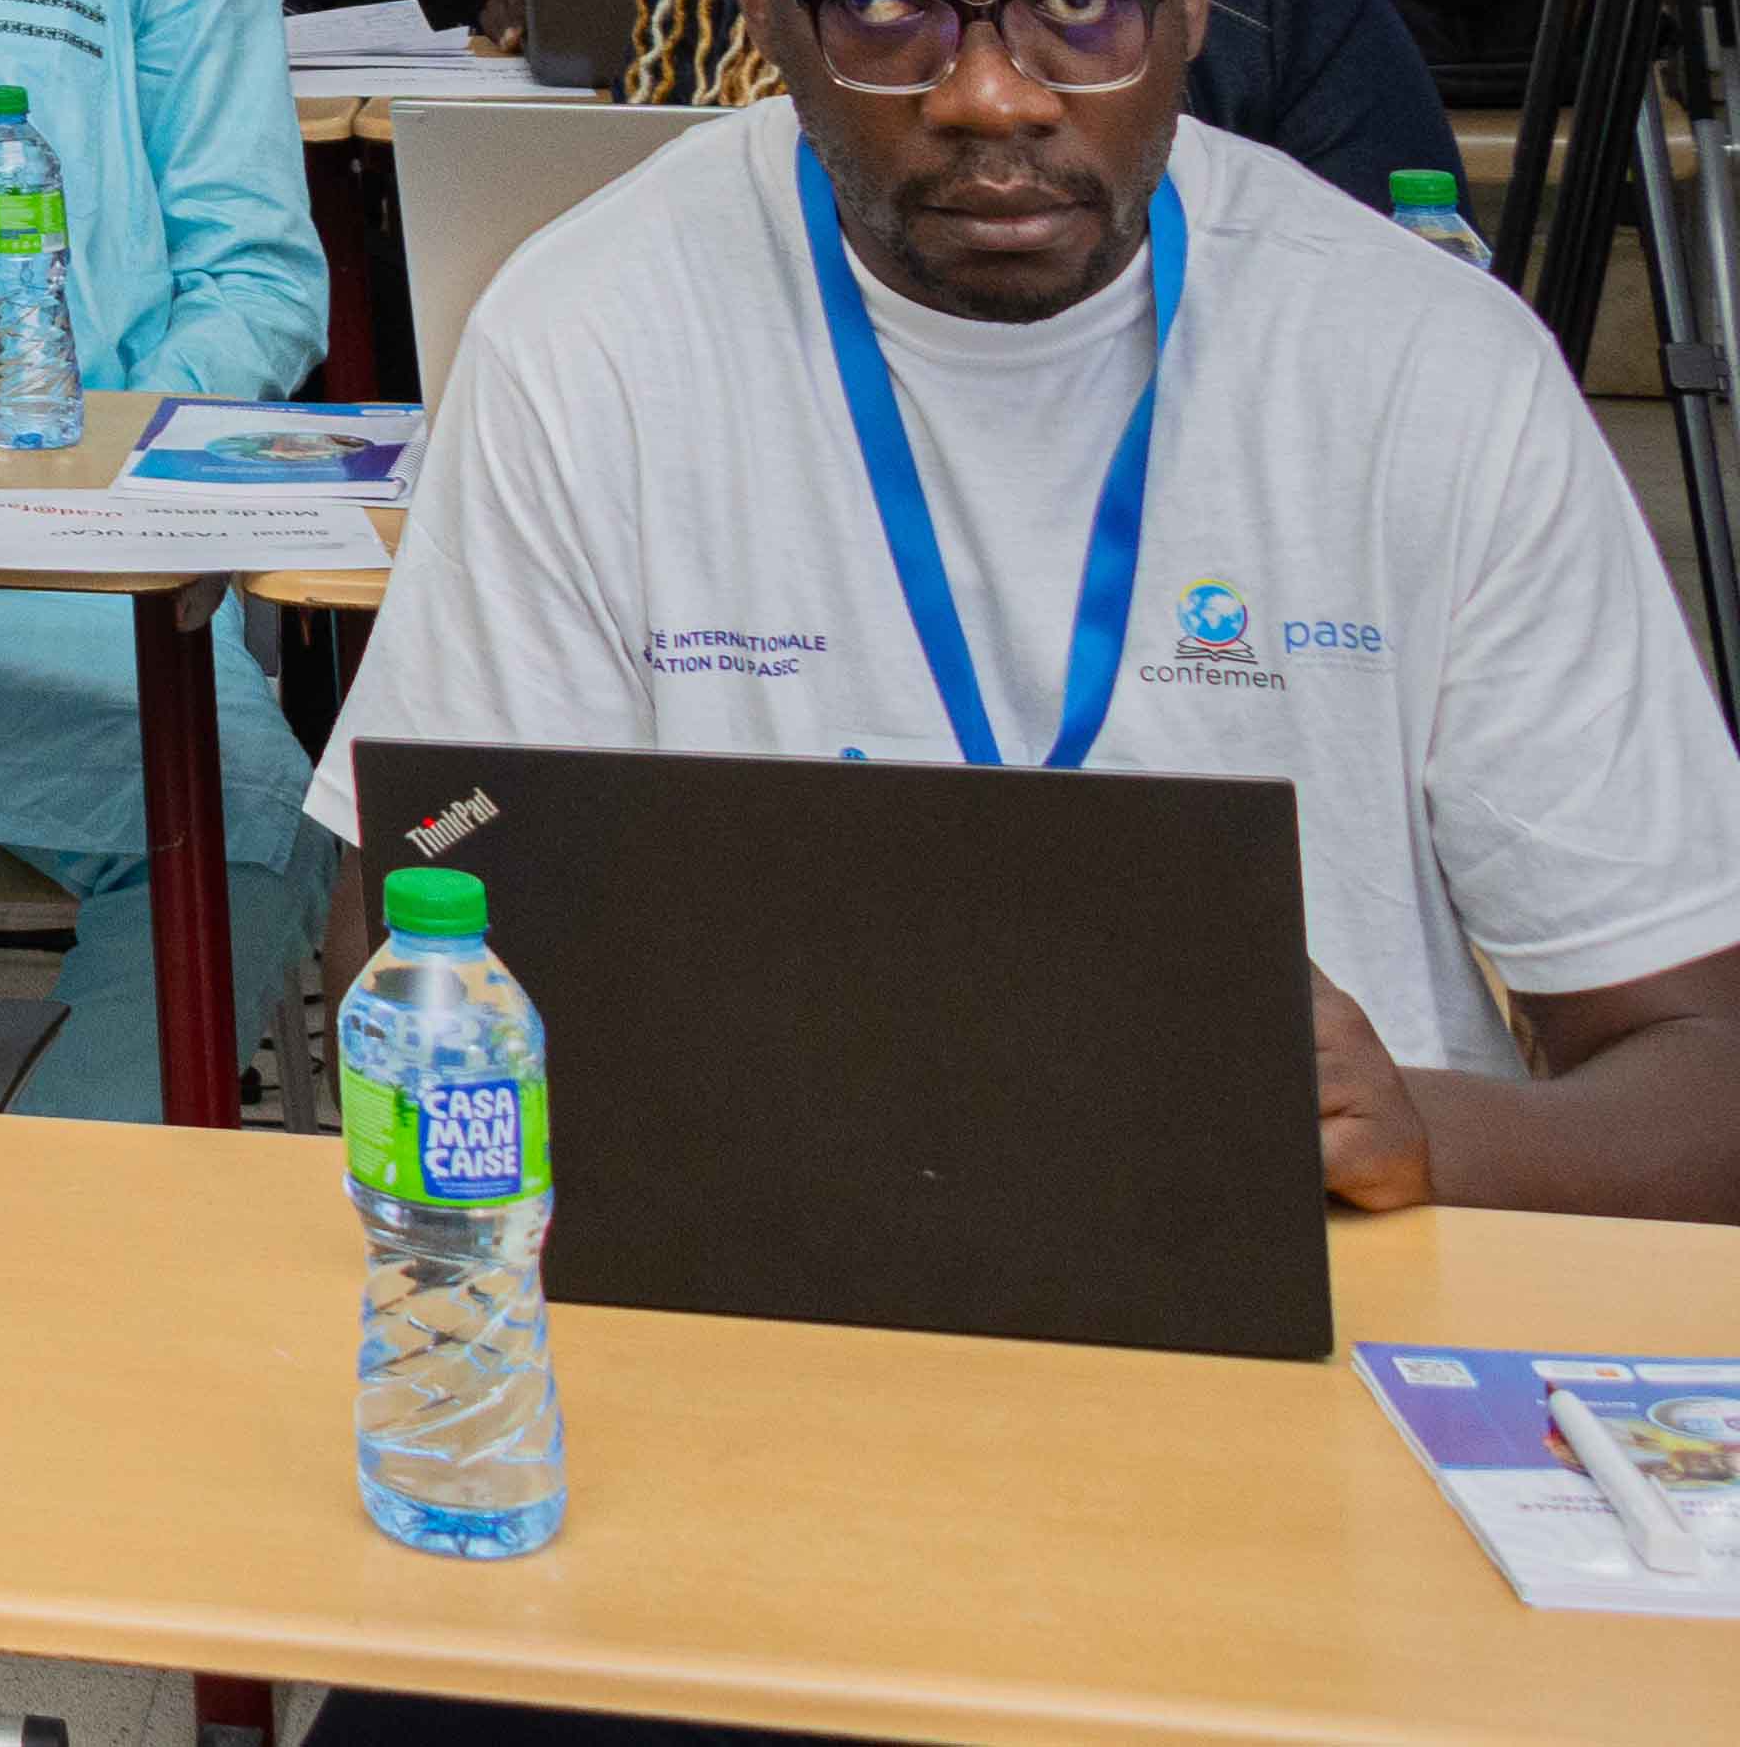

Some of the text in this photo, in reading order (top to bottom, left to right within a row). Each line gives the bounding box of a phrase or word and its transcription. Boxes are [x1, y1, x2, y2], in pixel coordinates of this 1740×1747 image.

[674, 630, 828, 652] INTERNATIONALE
[1283, 620, 1384, 654] pase
[646, 654, 800, 677] ATION DU PASEC
[1139, 662, 1287, 692] confemen
[404, 787, 500, 859] ThinkPad
[423, 1087, 516, 1120] CASA
[427, 1118, 516, 1148] MAN
